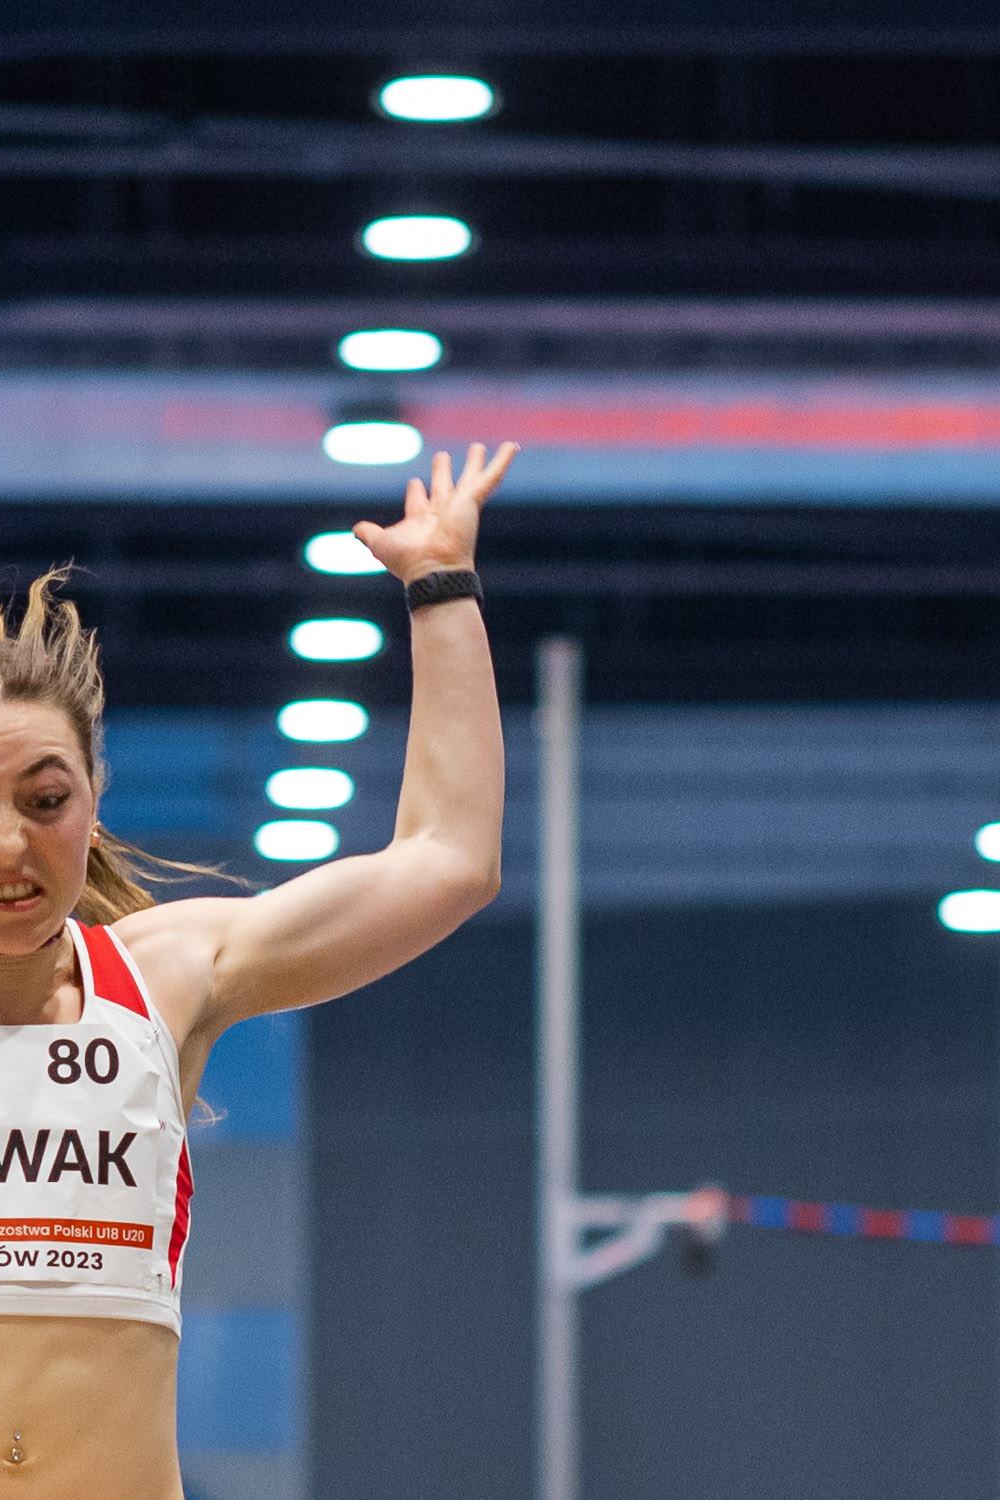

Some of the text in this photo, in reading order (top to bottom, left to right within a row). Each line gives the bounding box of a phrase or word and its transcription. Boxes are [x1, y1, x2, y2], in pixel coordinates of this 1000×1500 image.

[47, 1037, 120, 1085] 80
[53, 1223, 93, 1239] Polski
[96, 1226, 119, 1240] U18
[122, 1228, 146, 1243] U20
[46, 1249, 104, 1271] 2023
